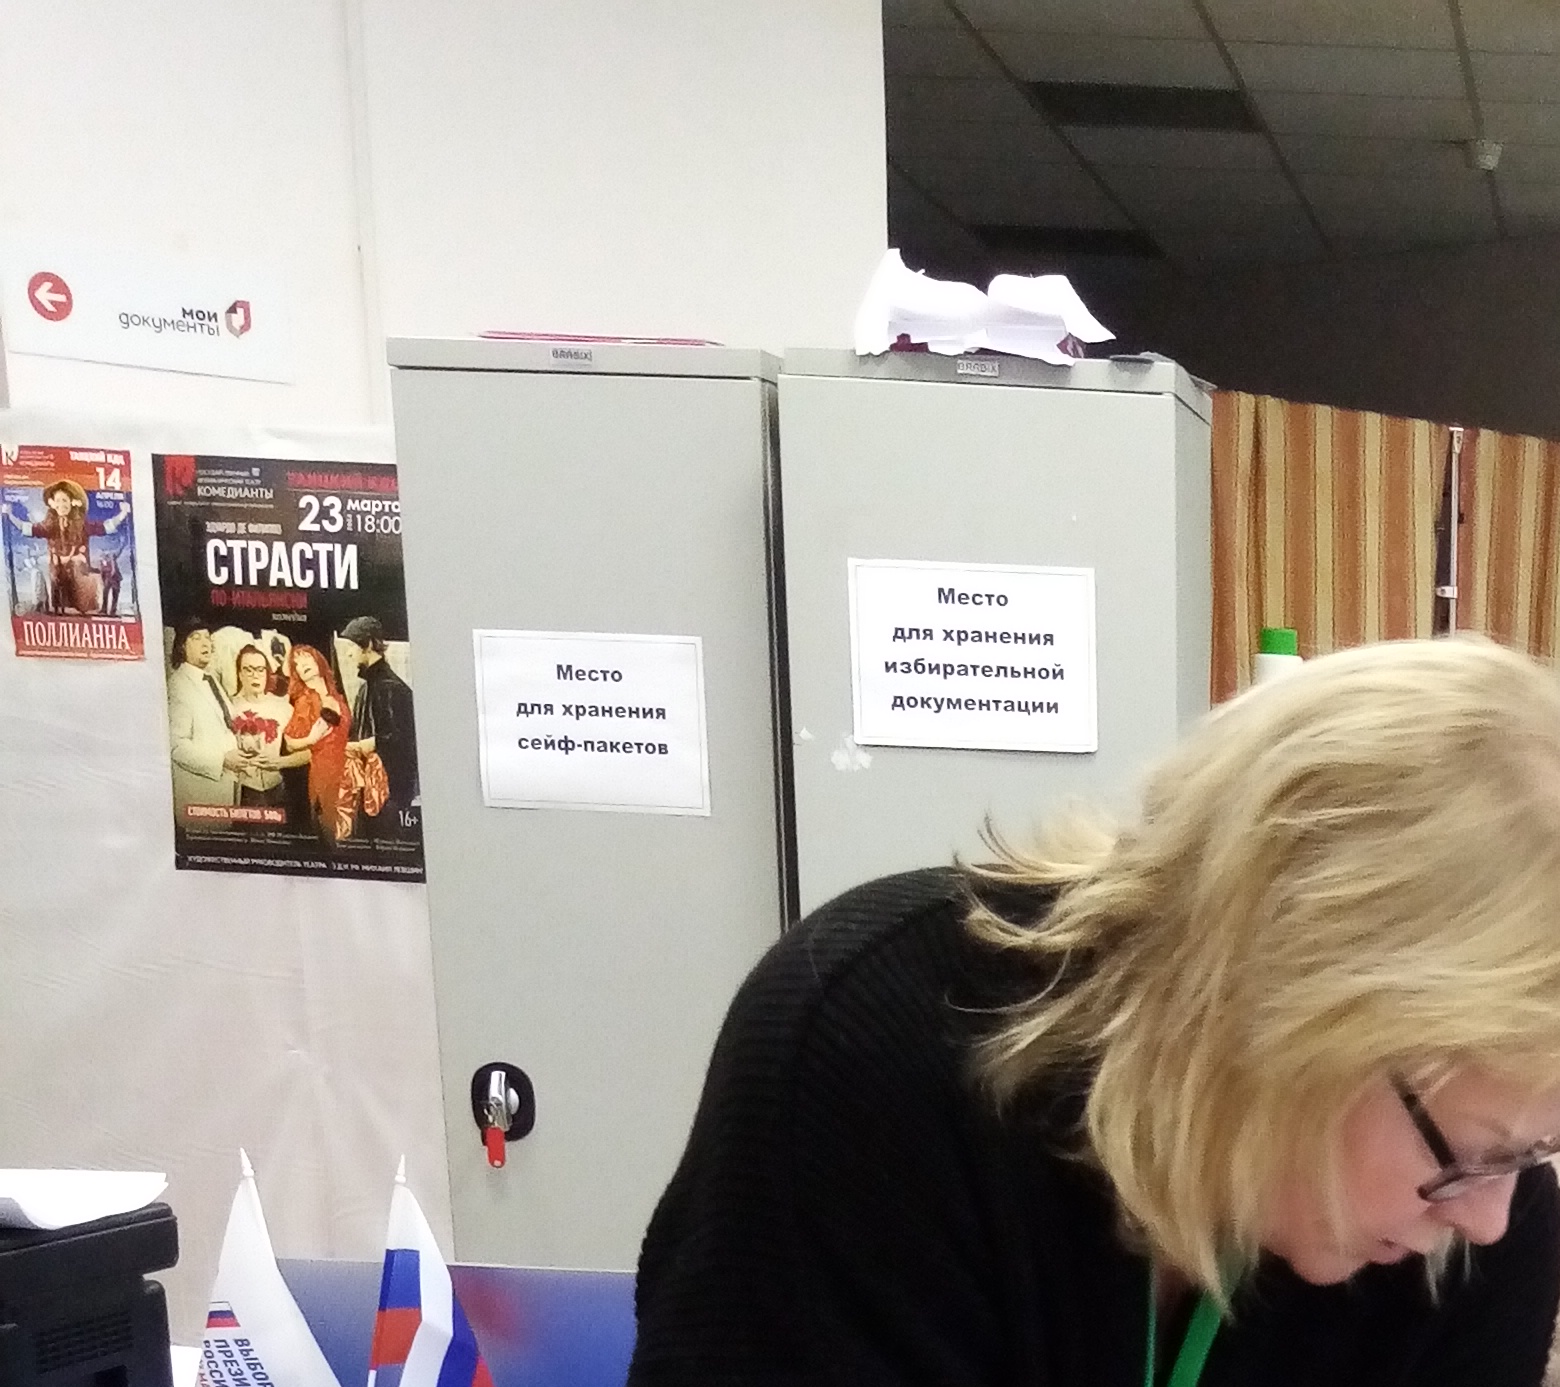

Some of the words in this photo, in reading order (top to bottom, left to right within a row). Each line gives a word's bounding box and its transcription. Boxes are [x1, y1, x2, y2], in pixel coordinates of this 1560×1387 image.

[118, 311, 221, 337] документы
[95, 466, 122, 491] 14
[197, 485, 274, 499] КОМЕДИАНТЫ
[298, 494, 344, 533] 23
[356, 514, 402, 534] 18:00
[206, 538, 359, 590] СТРАСТИ
[937, 587, 1009, 607] Место
[23, 621, 132, 651] ПОЛЛИАННА
[892, 626, 934, 643] для
[942, 628, 1055, 646] хранения
[556, 663, 623, 683] Место
[884, 657, 1065, 680] избирательной
[516, 702, 555, 718] для
[562, 703, 667, 721] хранения
[891, 694, 1059, 716] документации
[517, 734, 669, 756] сейф-пакетов
[398, 810, 419, 828] 16+
